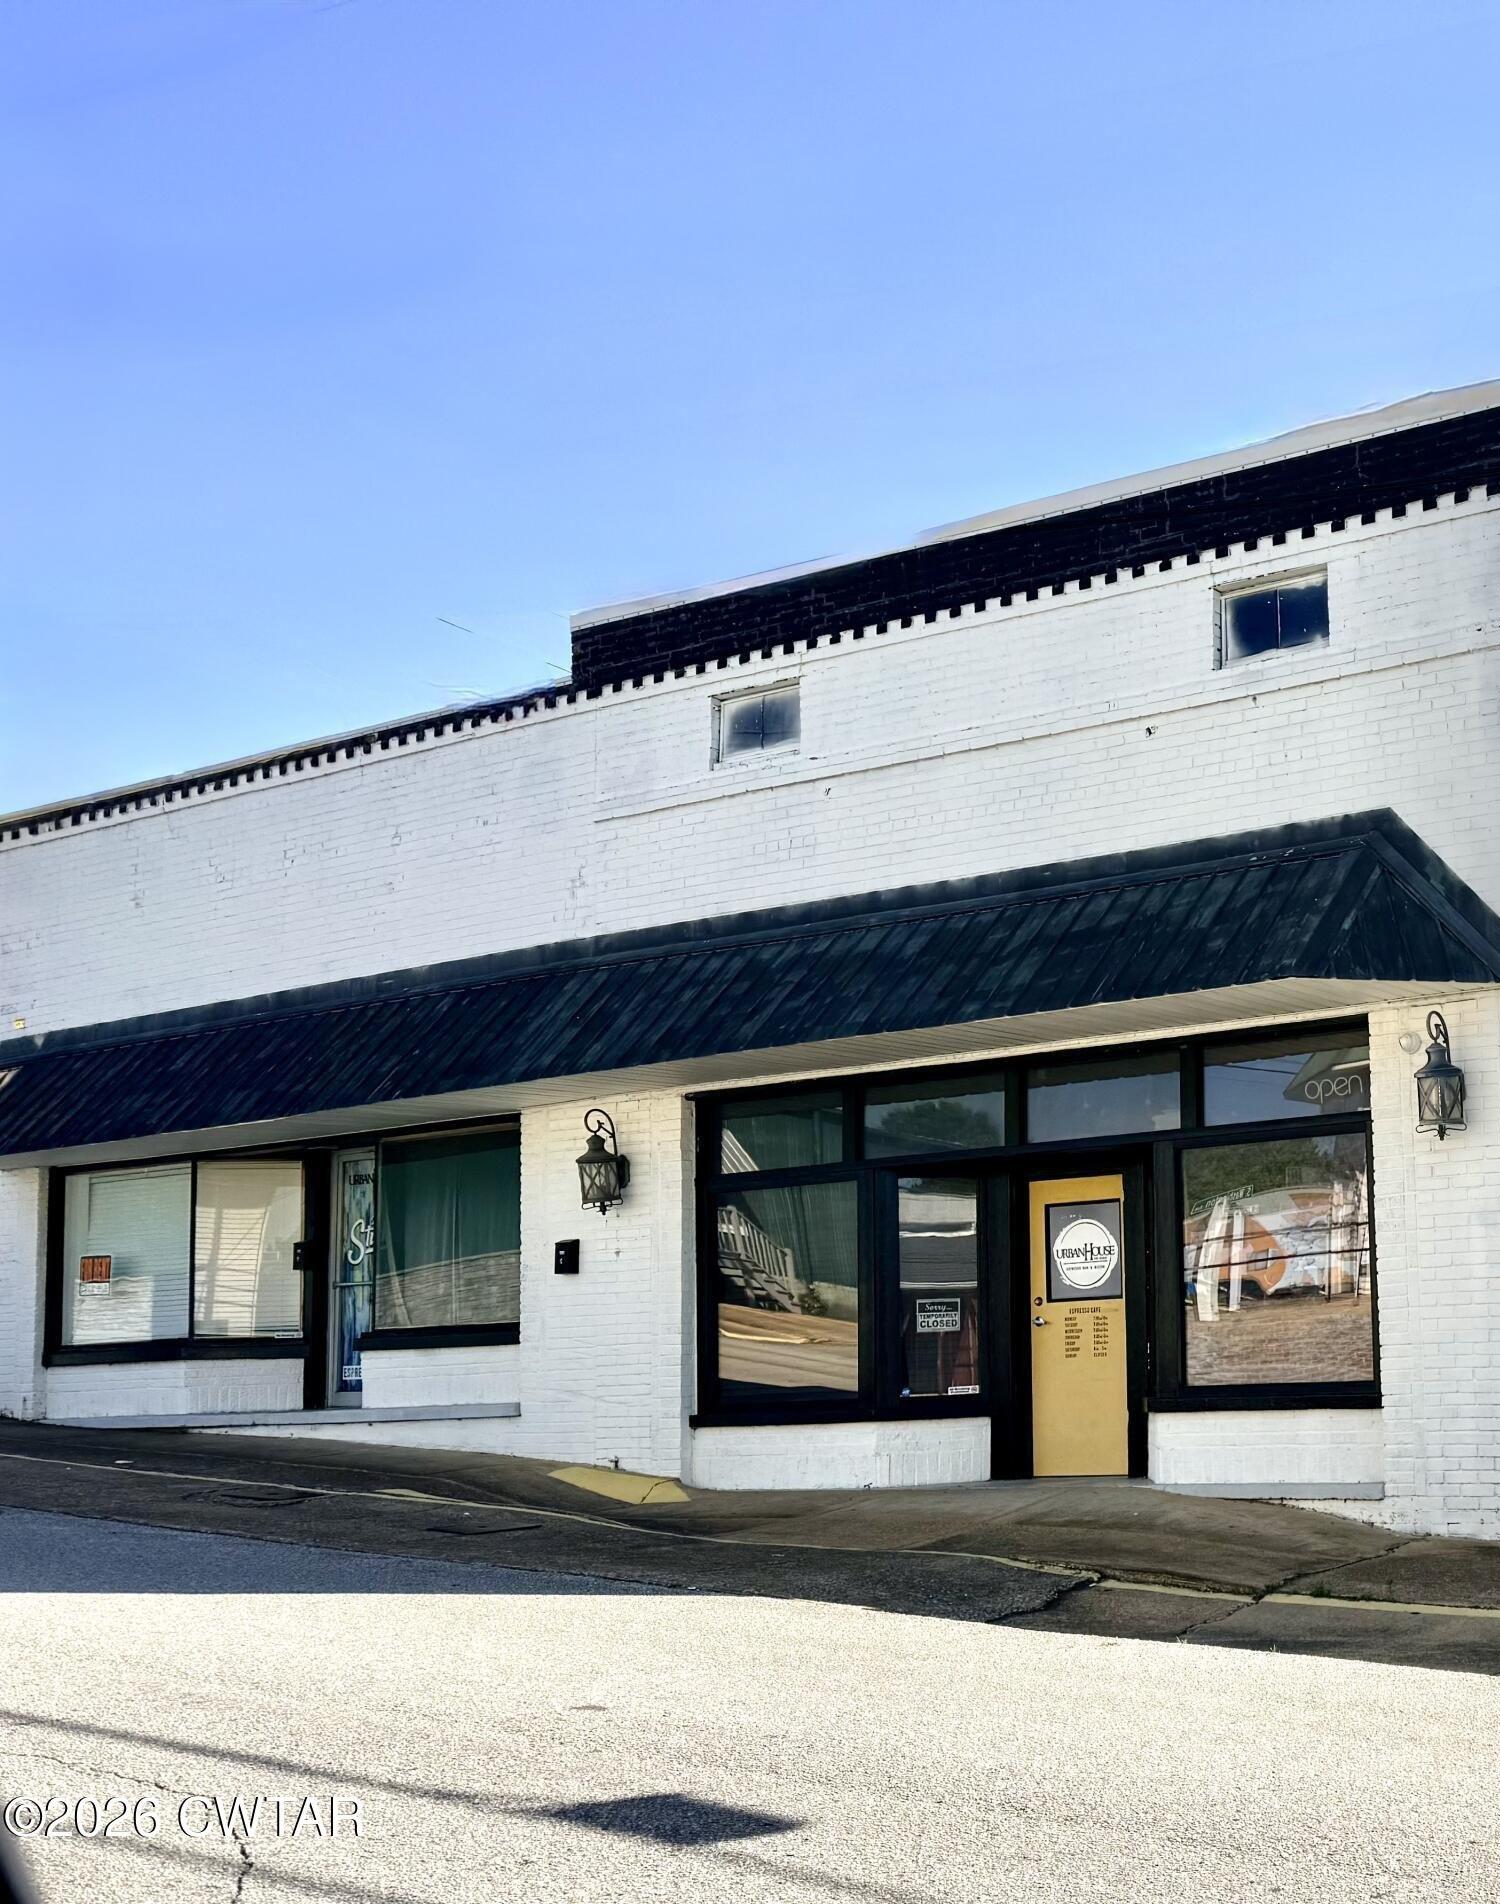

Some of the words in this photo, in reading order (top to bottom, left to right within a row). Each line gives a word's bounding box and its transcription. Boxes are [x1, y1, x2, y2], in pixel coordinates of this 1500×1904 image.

[1304, 1074, 1363, 1104] open
[920, 1312, 958, 1320] TEMPORARILY
[920, 1319, 958, 1329] CLOSED
